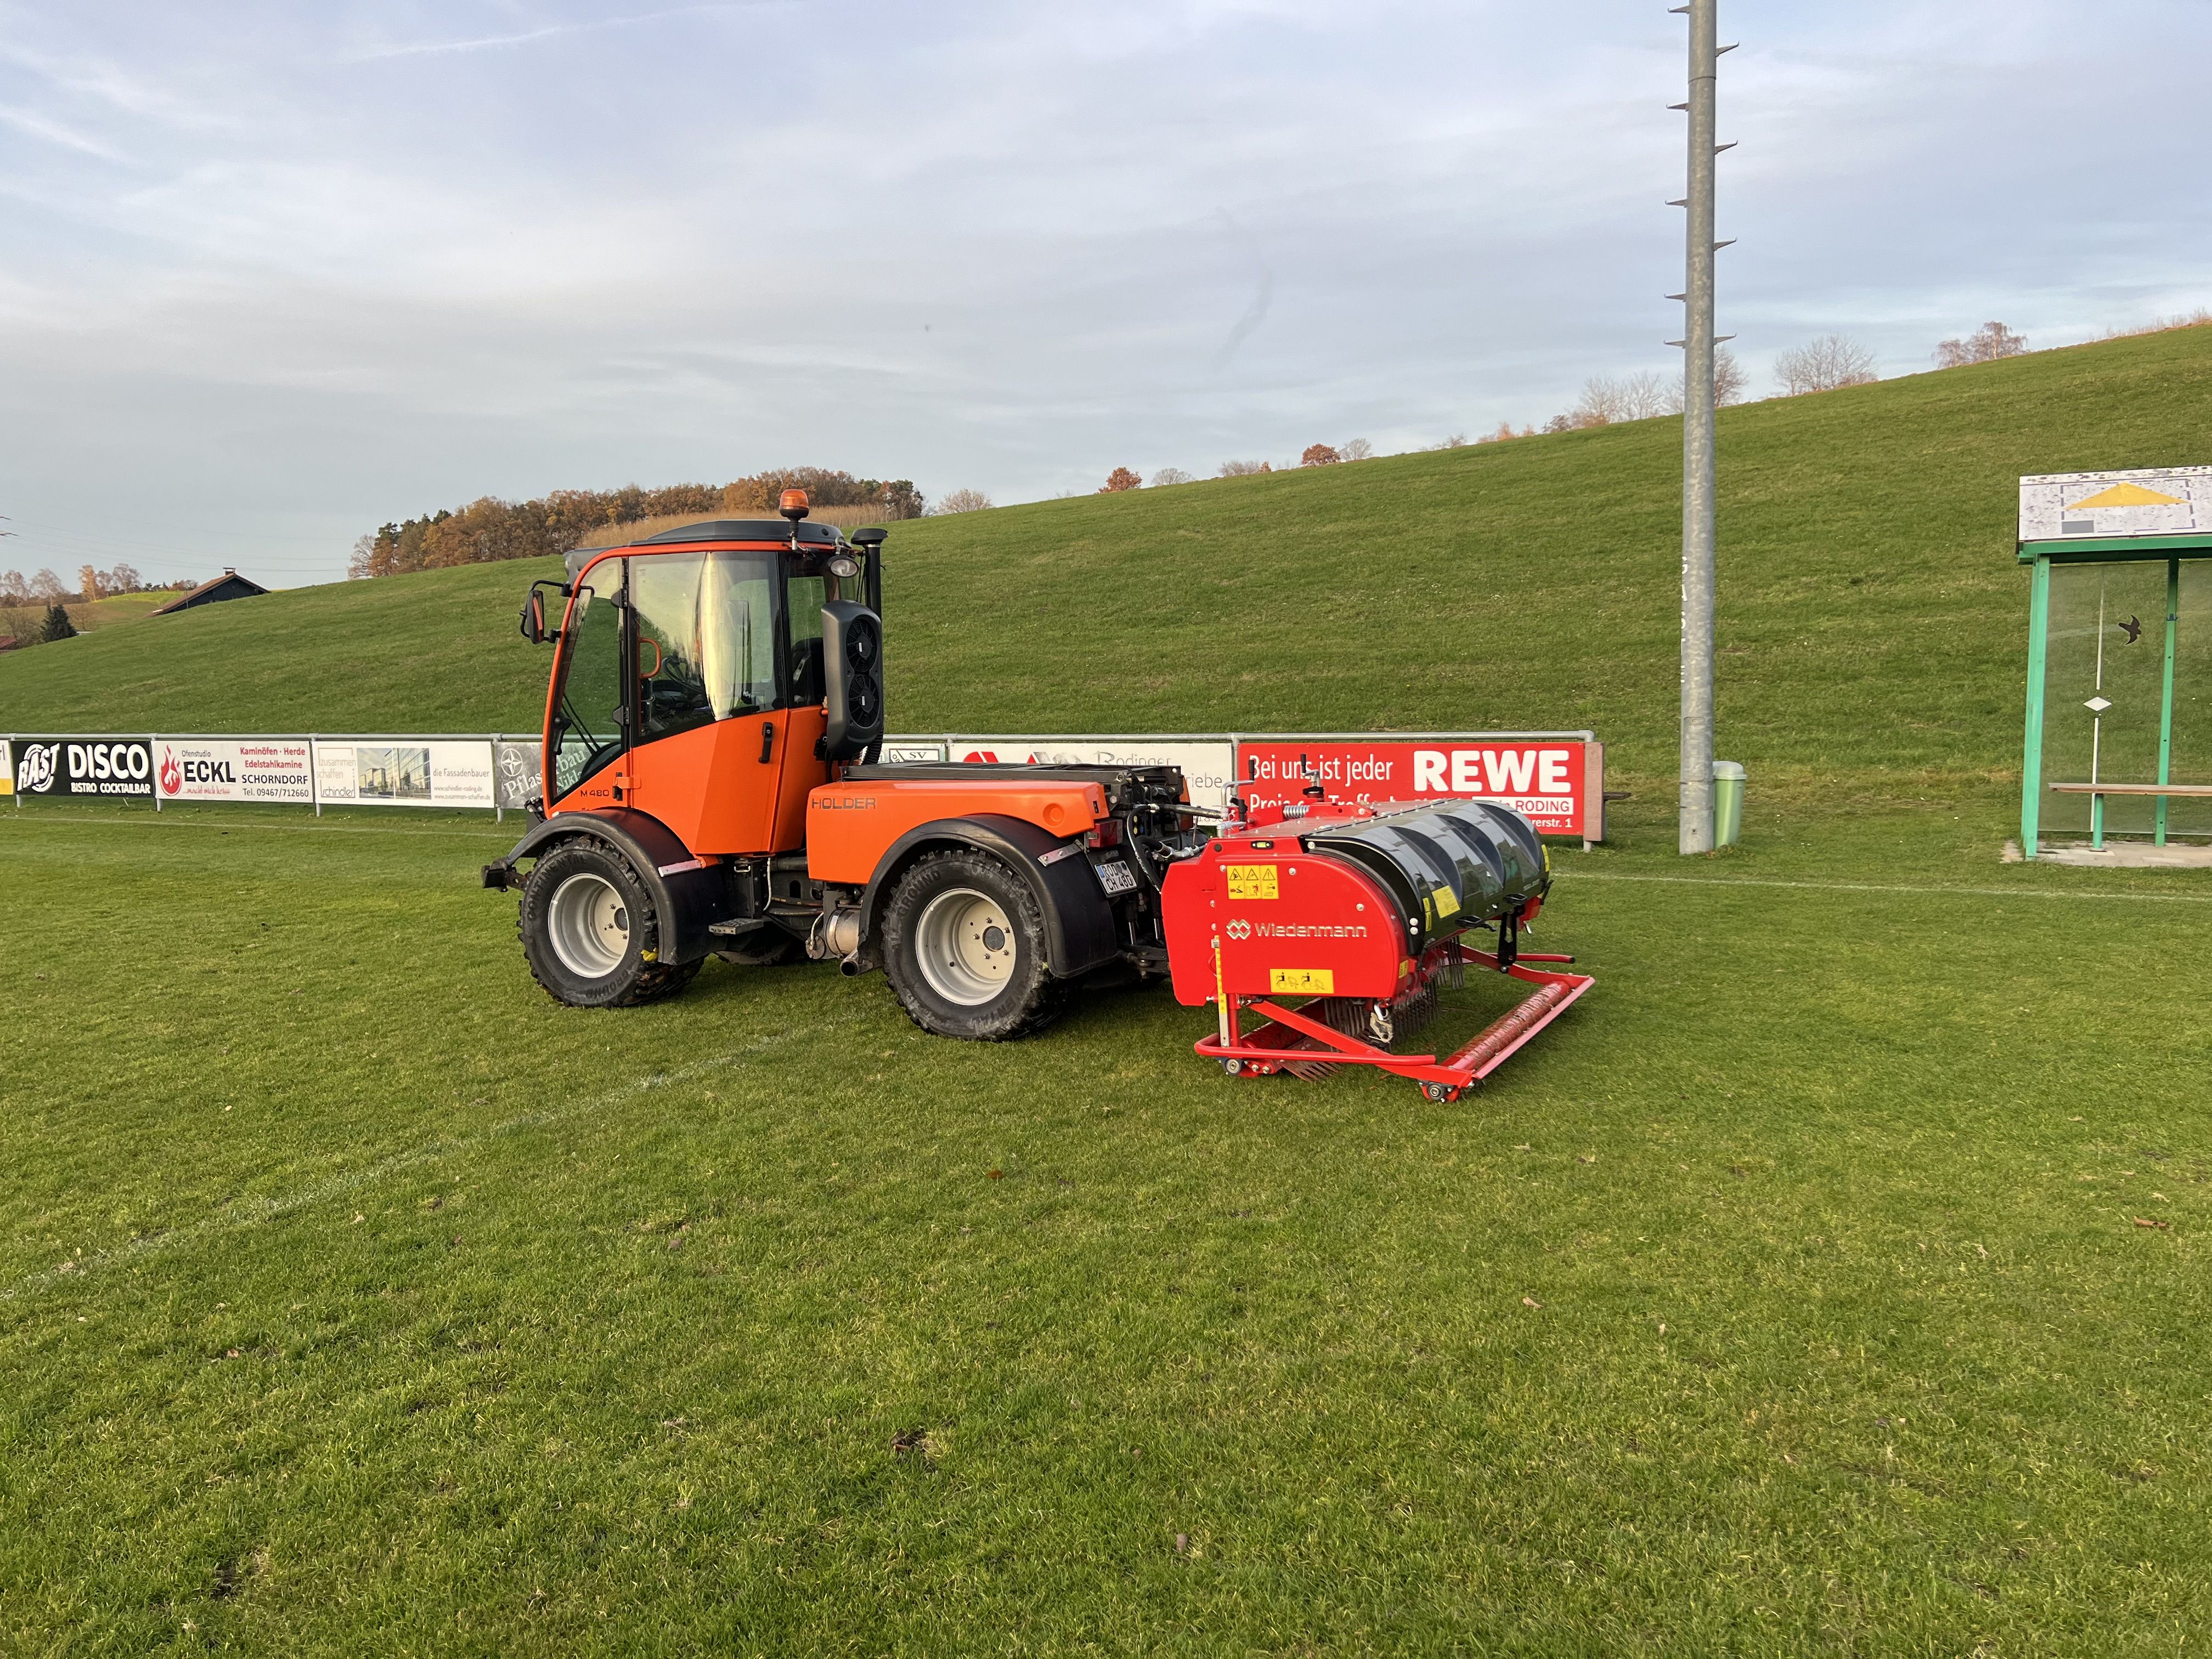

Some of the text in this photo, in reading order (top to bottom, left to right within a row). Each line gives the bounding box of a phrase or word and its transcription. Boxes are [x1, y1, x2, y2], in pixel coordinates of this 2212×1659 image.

[240, 747, 305, 755] Kaminöfen Herde
[17, 743, 60, 791] RAST
[67, 744, 149, 779] DISCO
[245, 760, 302, 768] Edelstahlkamine
[183, 760, 236, 782] ECKL
[316, 768, 343, 778] schaffen
[444, 769, 489, 777] Fassadenbauer
[1249, 754, 1276, 780] Bei
[1319, 754, 1341, 780] ist
[1345, 753, 1393, 787] jeder
[1414, 751, 1571, 793] REWE
[241, 775, 308, 784] SCHORNDORF
[71, 782, 151, 794] BISTRO COCKTAILBAR
[243, 788, 308, 798] Tel. 09467/712660
[322, 786, 354, 797] schindler
[812, 798, 876, 809] HOLDER
[1515, 800, 1570, 812] RODING
[1565, 817, 1573, 827] 1
[527, 854, 588, 919] CONTINENTAL
[1254, 922, 1367, 937] Wiedenmann
